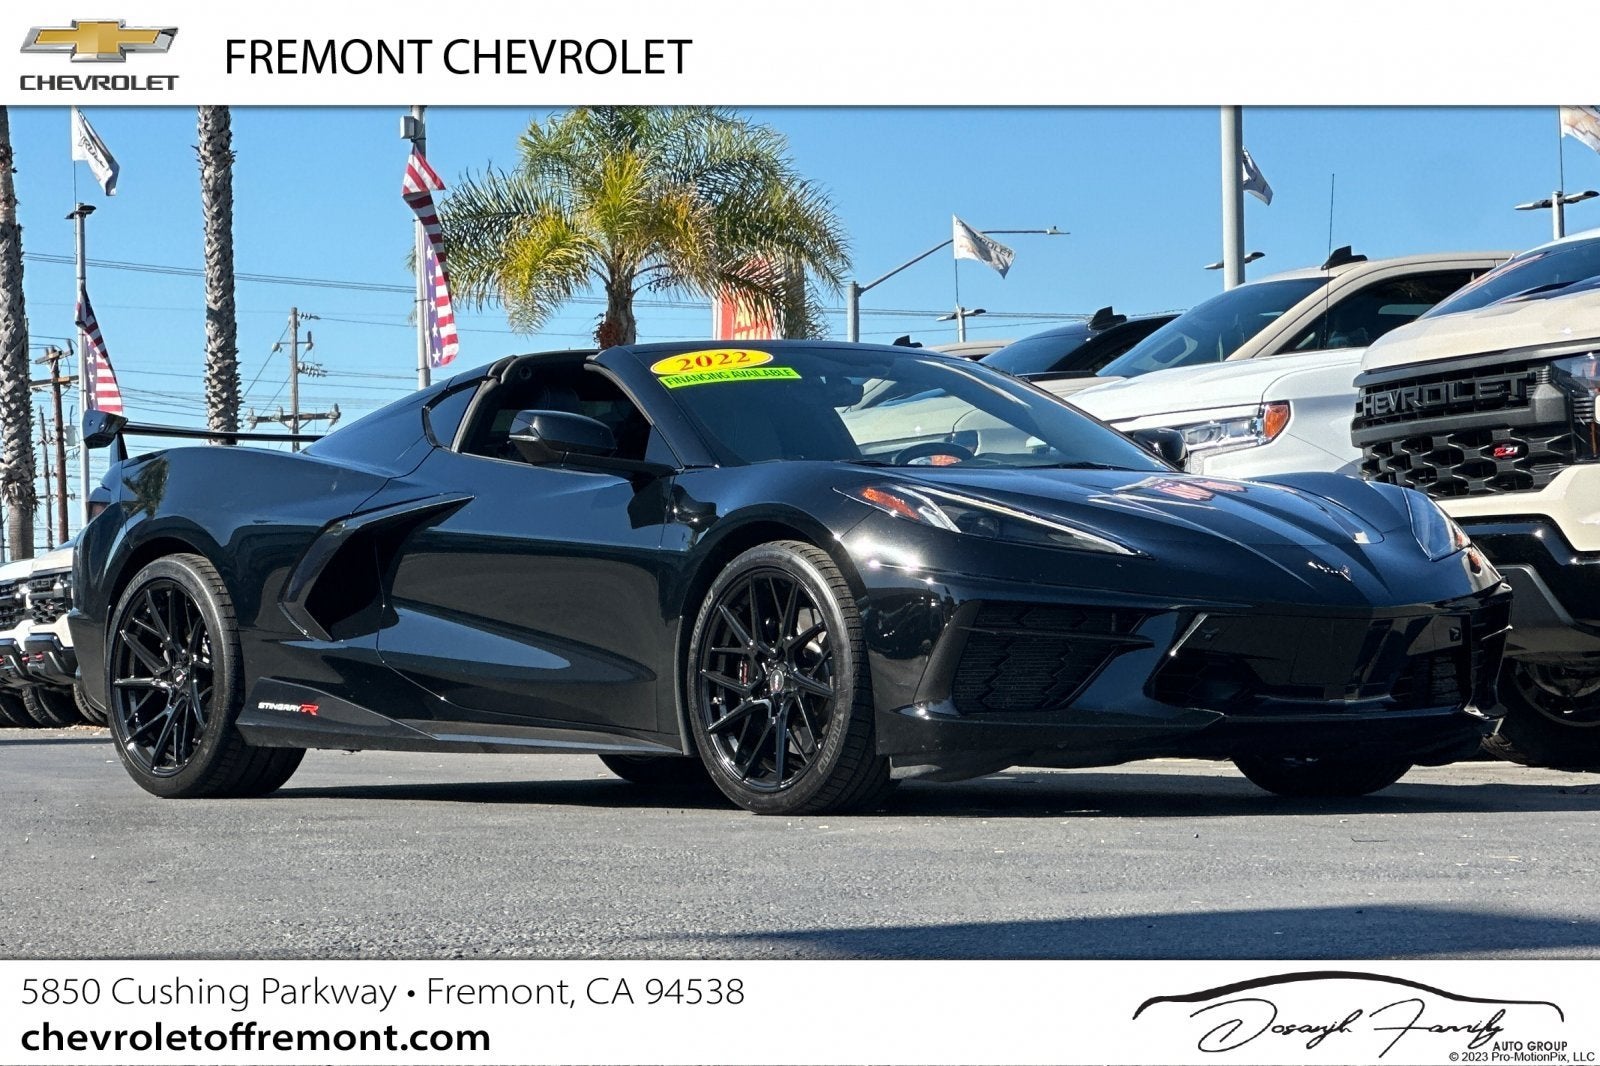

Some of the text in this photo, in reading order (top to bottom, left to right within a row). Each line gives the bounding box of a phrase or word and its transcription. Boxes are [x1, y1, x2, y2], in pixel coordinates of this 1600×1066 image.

[676, 351, 751, 371] 2022
[664, 367, 792, 386] FINANCING AVAILABLE
